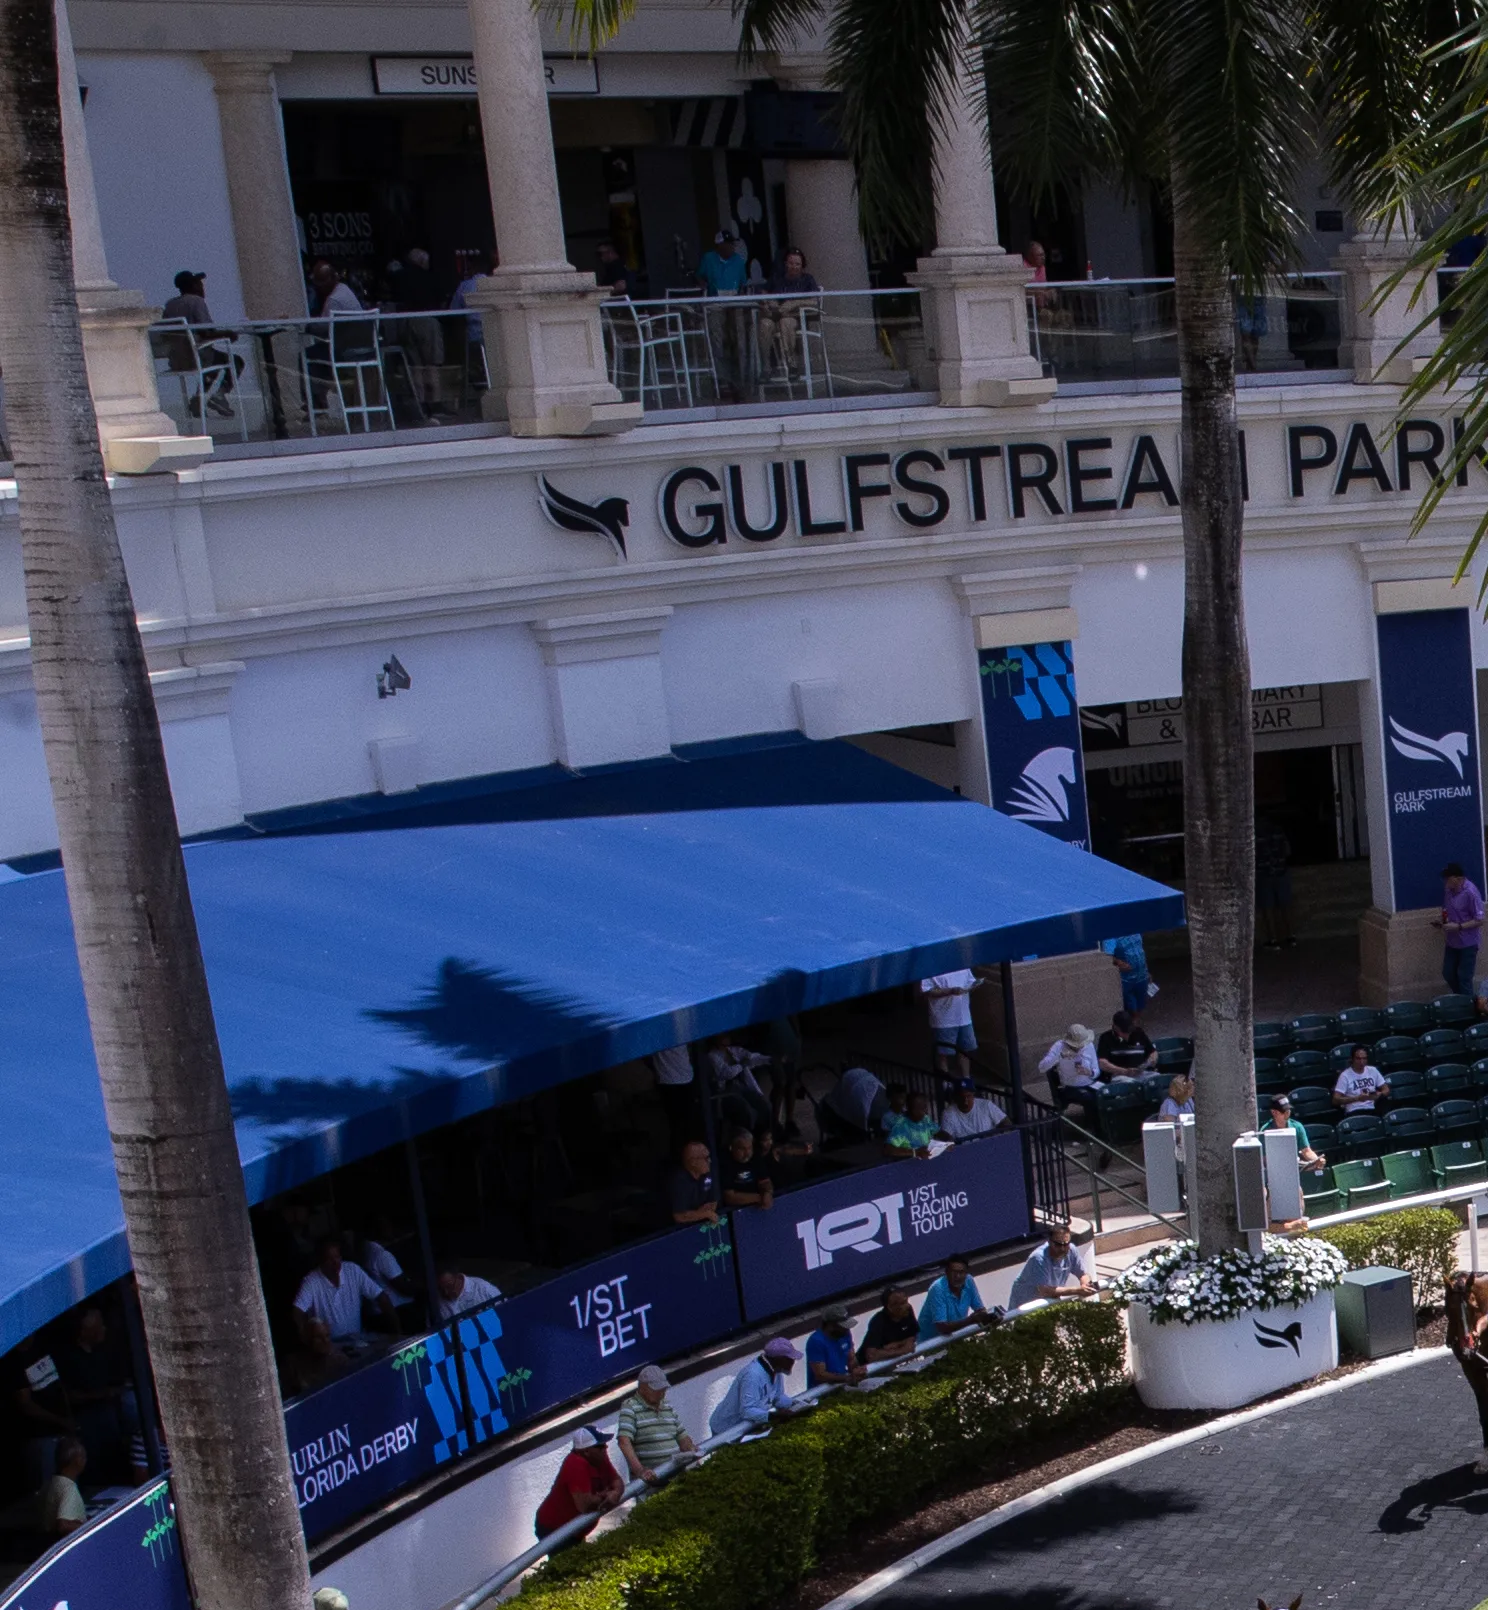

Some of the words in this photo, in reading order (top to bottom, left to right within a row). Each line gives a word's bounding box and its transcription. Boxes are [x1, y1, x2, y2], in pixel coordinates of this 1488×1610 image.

[421, 66, 477, 85] SUNS
[308, 212, 320, 239] 3
[322, 212, 373, 238] SONS
[660, 430, 1249, 548] GULFSTREA
[1137, 698, 1183, 714] BLO
[1159, 719, 1176, 739] &
[1394, 785, 1471, 803] GULFSTREAM
[1395, 800, 1426, 814] PARK
[1353, 1078, 1374, 1091] AERO
[907, 1183, 938, 1204] 1/ST
[910, 1191, 968, 1221] RACING
[911, 1212, 954, 1237] TOUR
[569, 1275, 628, 1329] 1/ST
[598, 1303, 652, 1357] BET
[291, 1423, 351, 1476] URLIN
[294, 1453, 360, 1509] LORIDA
[360, 1417, 418, 1472] DERBY
